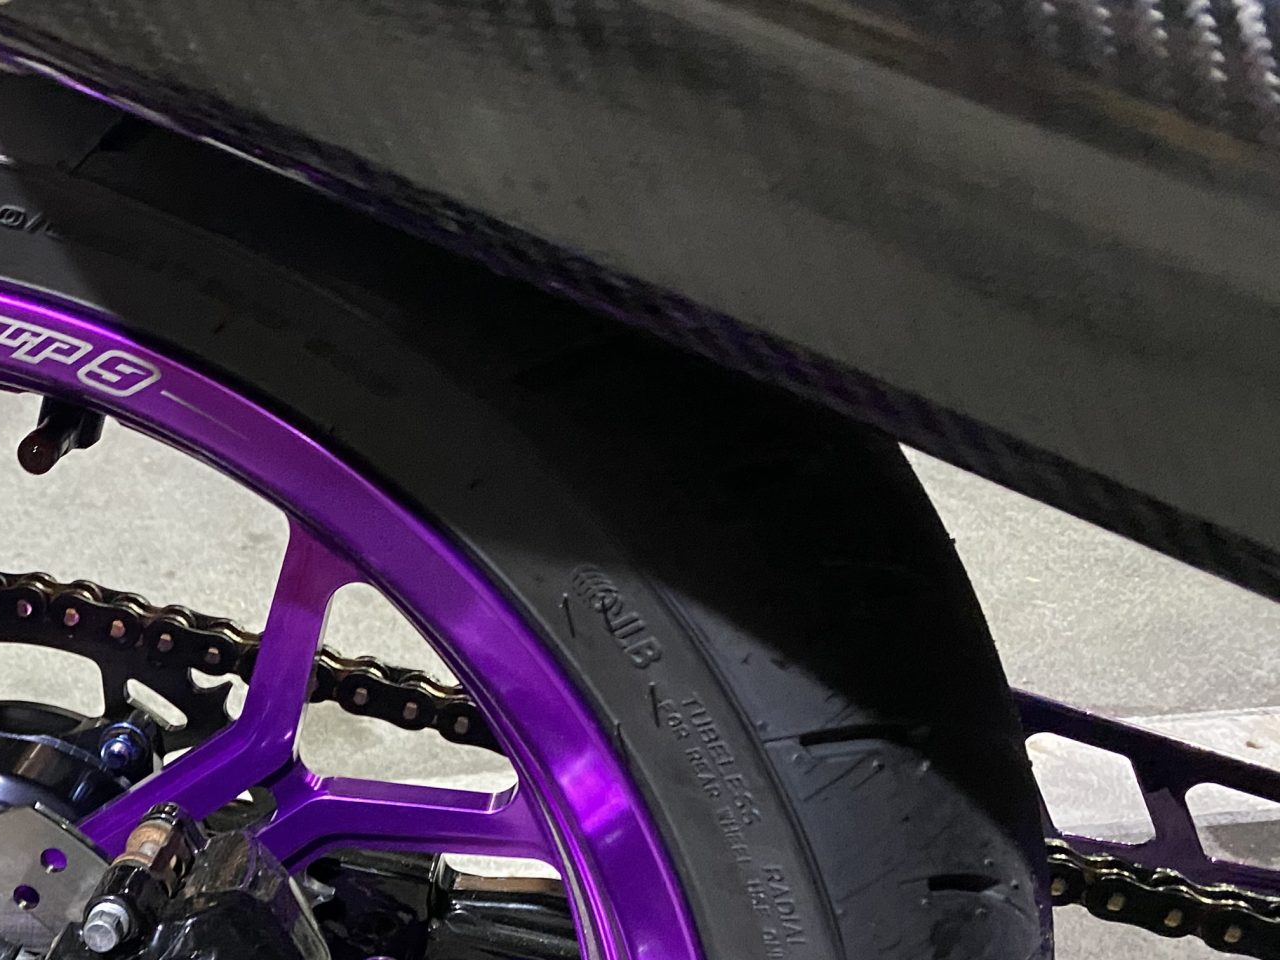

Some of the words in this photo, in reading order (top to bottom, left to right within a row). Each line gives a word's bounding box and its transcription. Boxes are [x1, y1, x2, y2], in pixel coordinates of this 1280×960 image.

[77, 349, 162, 397] 9
[658, 697, 690, 741] FOR
[685, 746, 720, 800] REAR
[681, 692, 762, 828] TUBELESS
[762, 863, 807, 947] RADIAL
